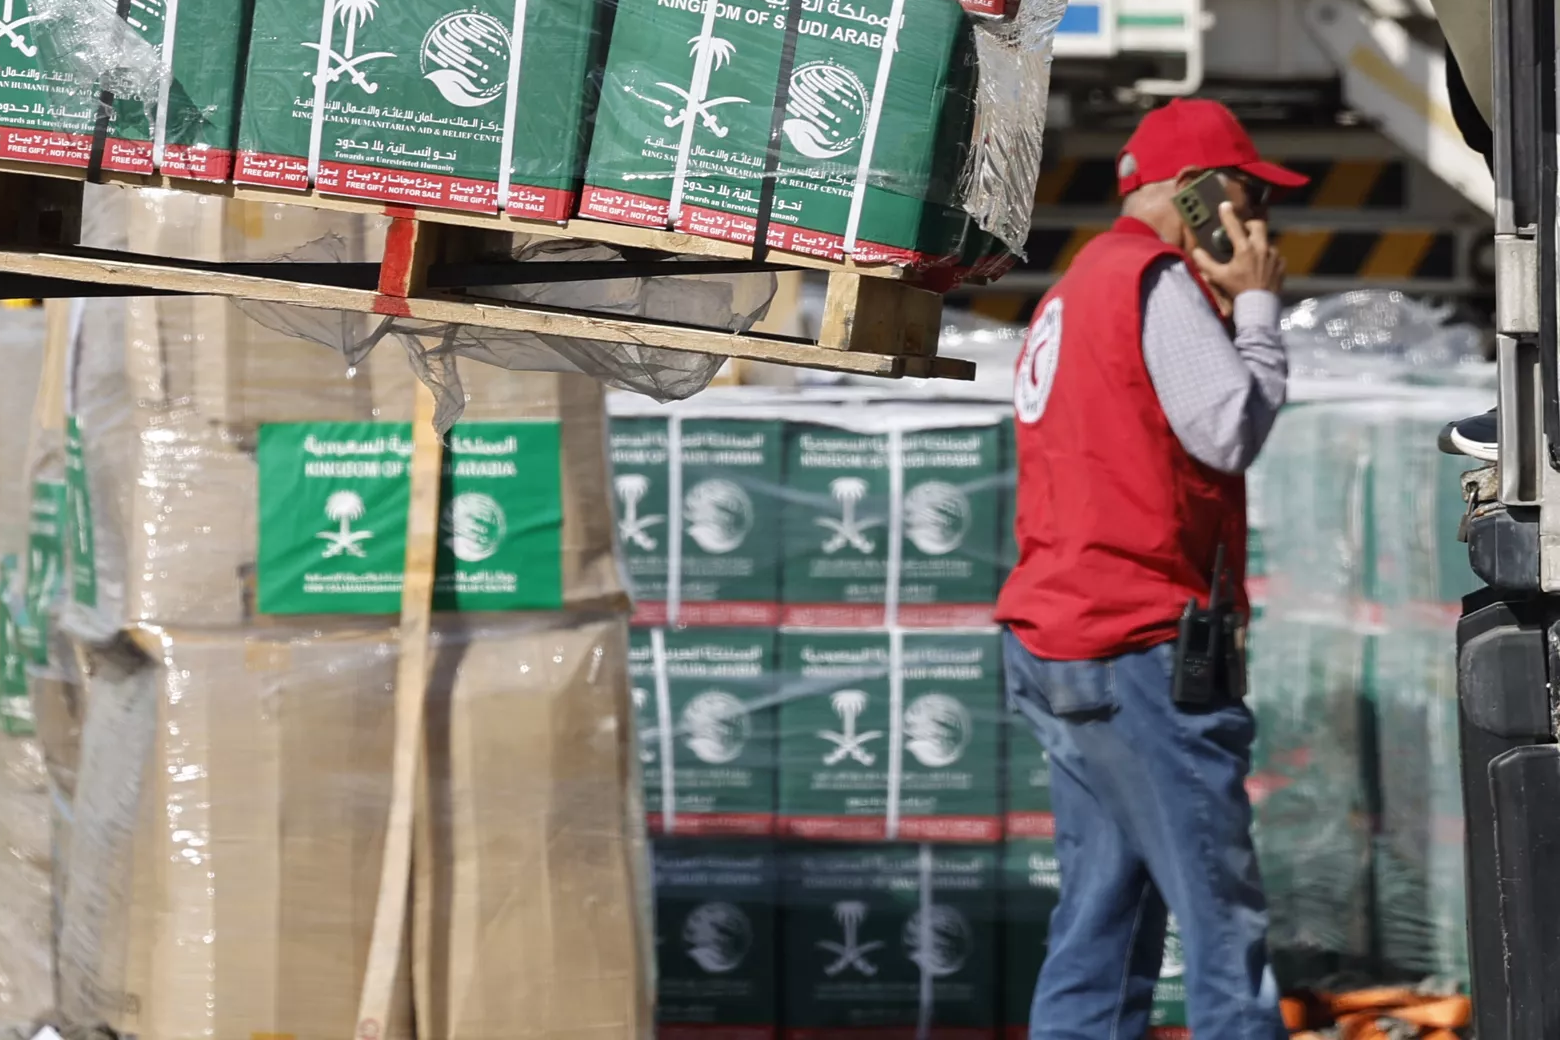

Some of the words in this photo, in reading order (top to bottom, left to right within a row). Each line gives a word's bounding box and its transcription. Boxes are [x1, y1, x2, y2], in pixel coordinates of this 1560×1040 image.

[745, 9, 769, 25] OF
[773, 14, 827, 37] SUDI
[292, 111, 313, 120] KING
[314, 113, 348, 123] LMAN
[351, 118, 415, 131] HUMANITARIAN
[442, 129, 472, 138] RELIEF
[473, 133, 507, 144] CENTE
[479, 119, 509, 134] ركز
[8, 144, 27, 152] FREE
[334, 150, 364, 160] Towards
[376, 156, 418, 167] Unrestricted
[420, 161, 454, 173] Humanity
[243, 168, 262, 176] FREE
[263, 170, 280, 178] GIFT
[318, 177, 337, 185] SALE
[346, 181, 365, 189] FREE
[367, 183, 383, 191] GIFT
[405, 188, 420, 196] FOR
[422, 190, 440, 198] SALE
[449, 194, 468, 202] FREE
[525, 203, 543, 211] SALE
[589, 202, 607, 211] FREE
